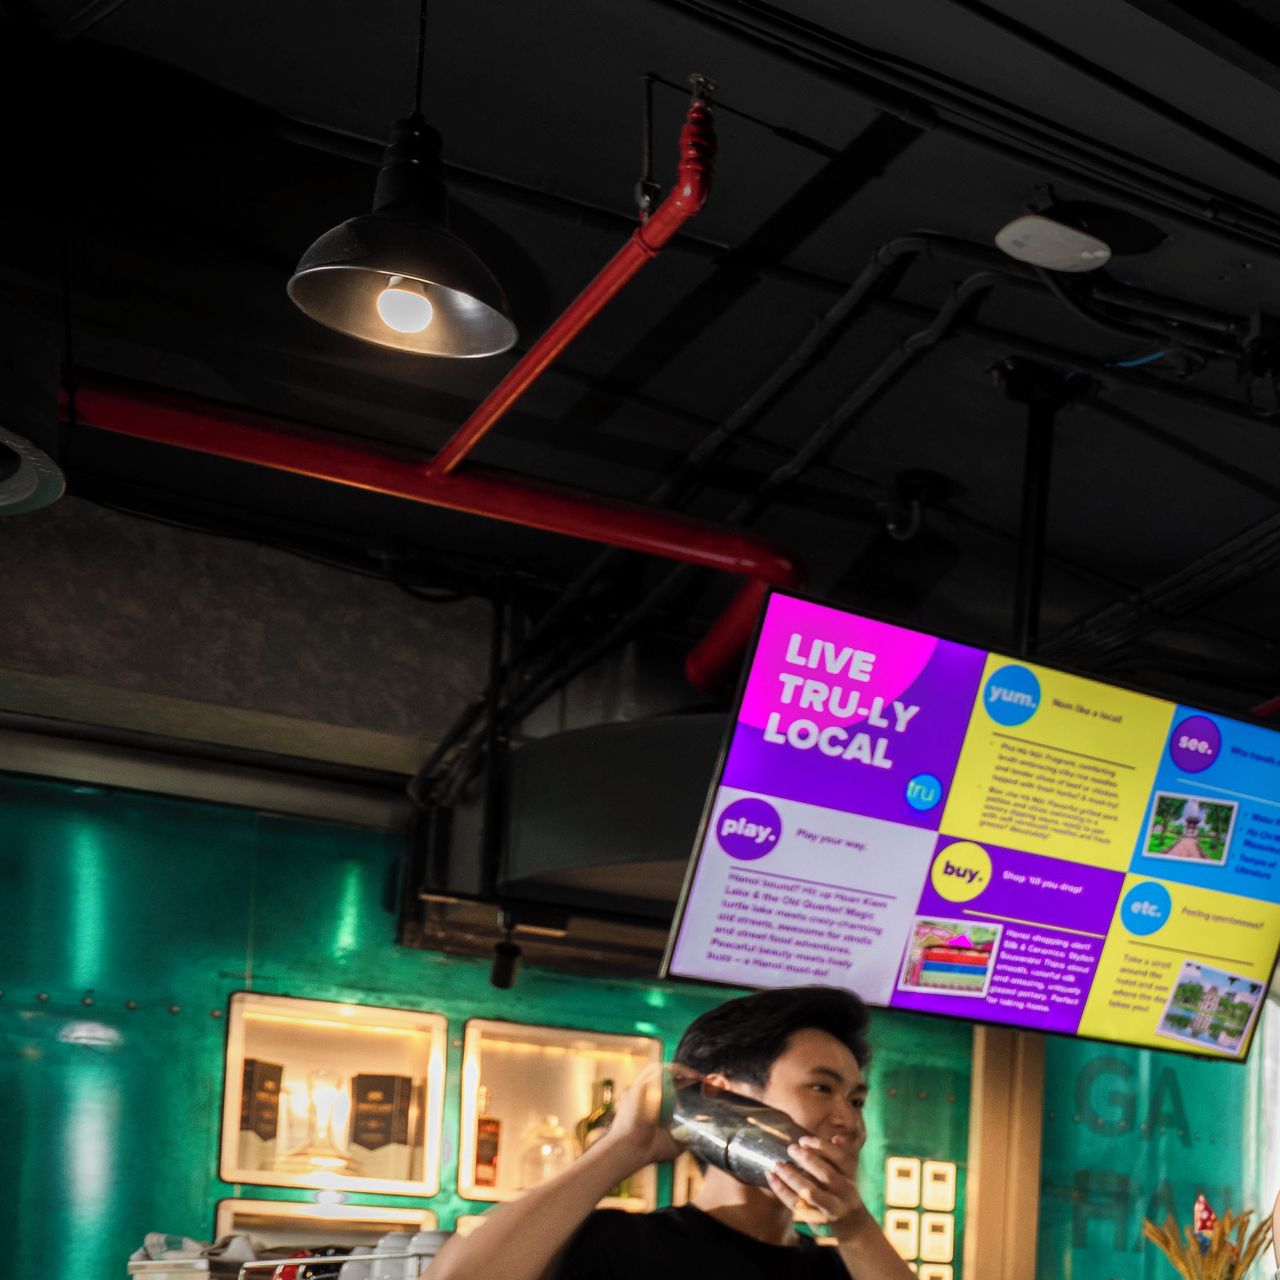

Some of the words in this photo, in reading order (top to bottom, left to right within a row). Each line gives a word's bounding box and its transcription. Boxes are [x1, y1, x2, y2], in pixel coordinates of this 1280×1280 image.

[785, 633, 876, 682] LIVE
[779, 672, 920, 733] TRU-LY
[988, 685, 1037, 713] yum.
[763, 711, 892, 769] LOCAL
[1179, 736, 1212, 755] see.
[906, 779, 935, 802] tru
[721, 818, 776, 842] play.
[795, 828, 817, 841] Play
[819, 835, 842, 845] your
[943, 861, 982, 883] buy.
[1002, 870, 1025, 882] Shop
[1041, 880, 1058, 889] you
[1130, 900, 1162, 918] etc.
[1074, 1056, 1192, 1148] GA
